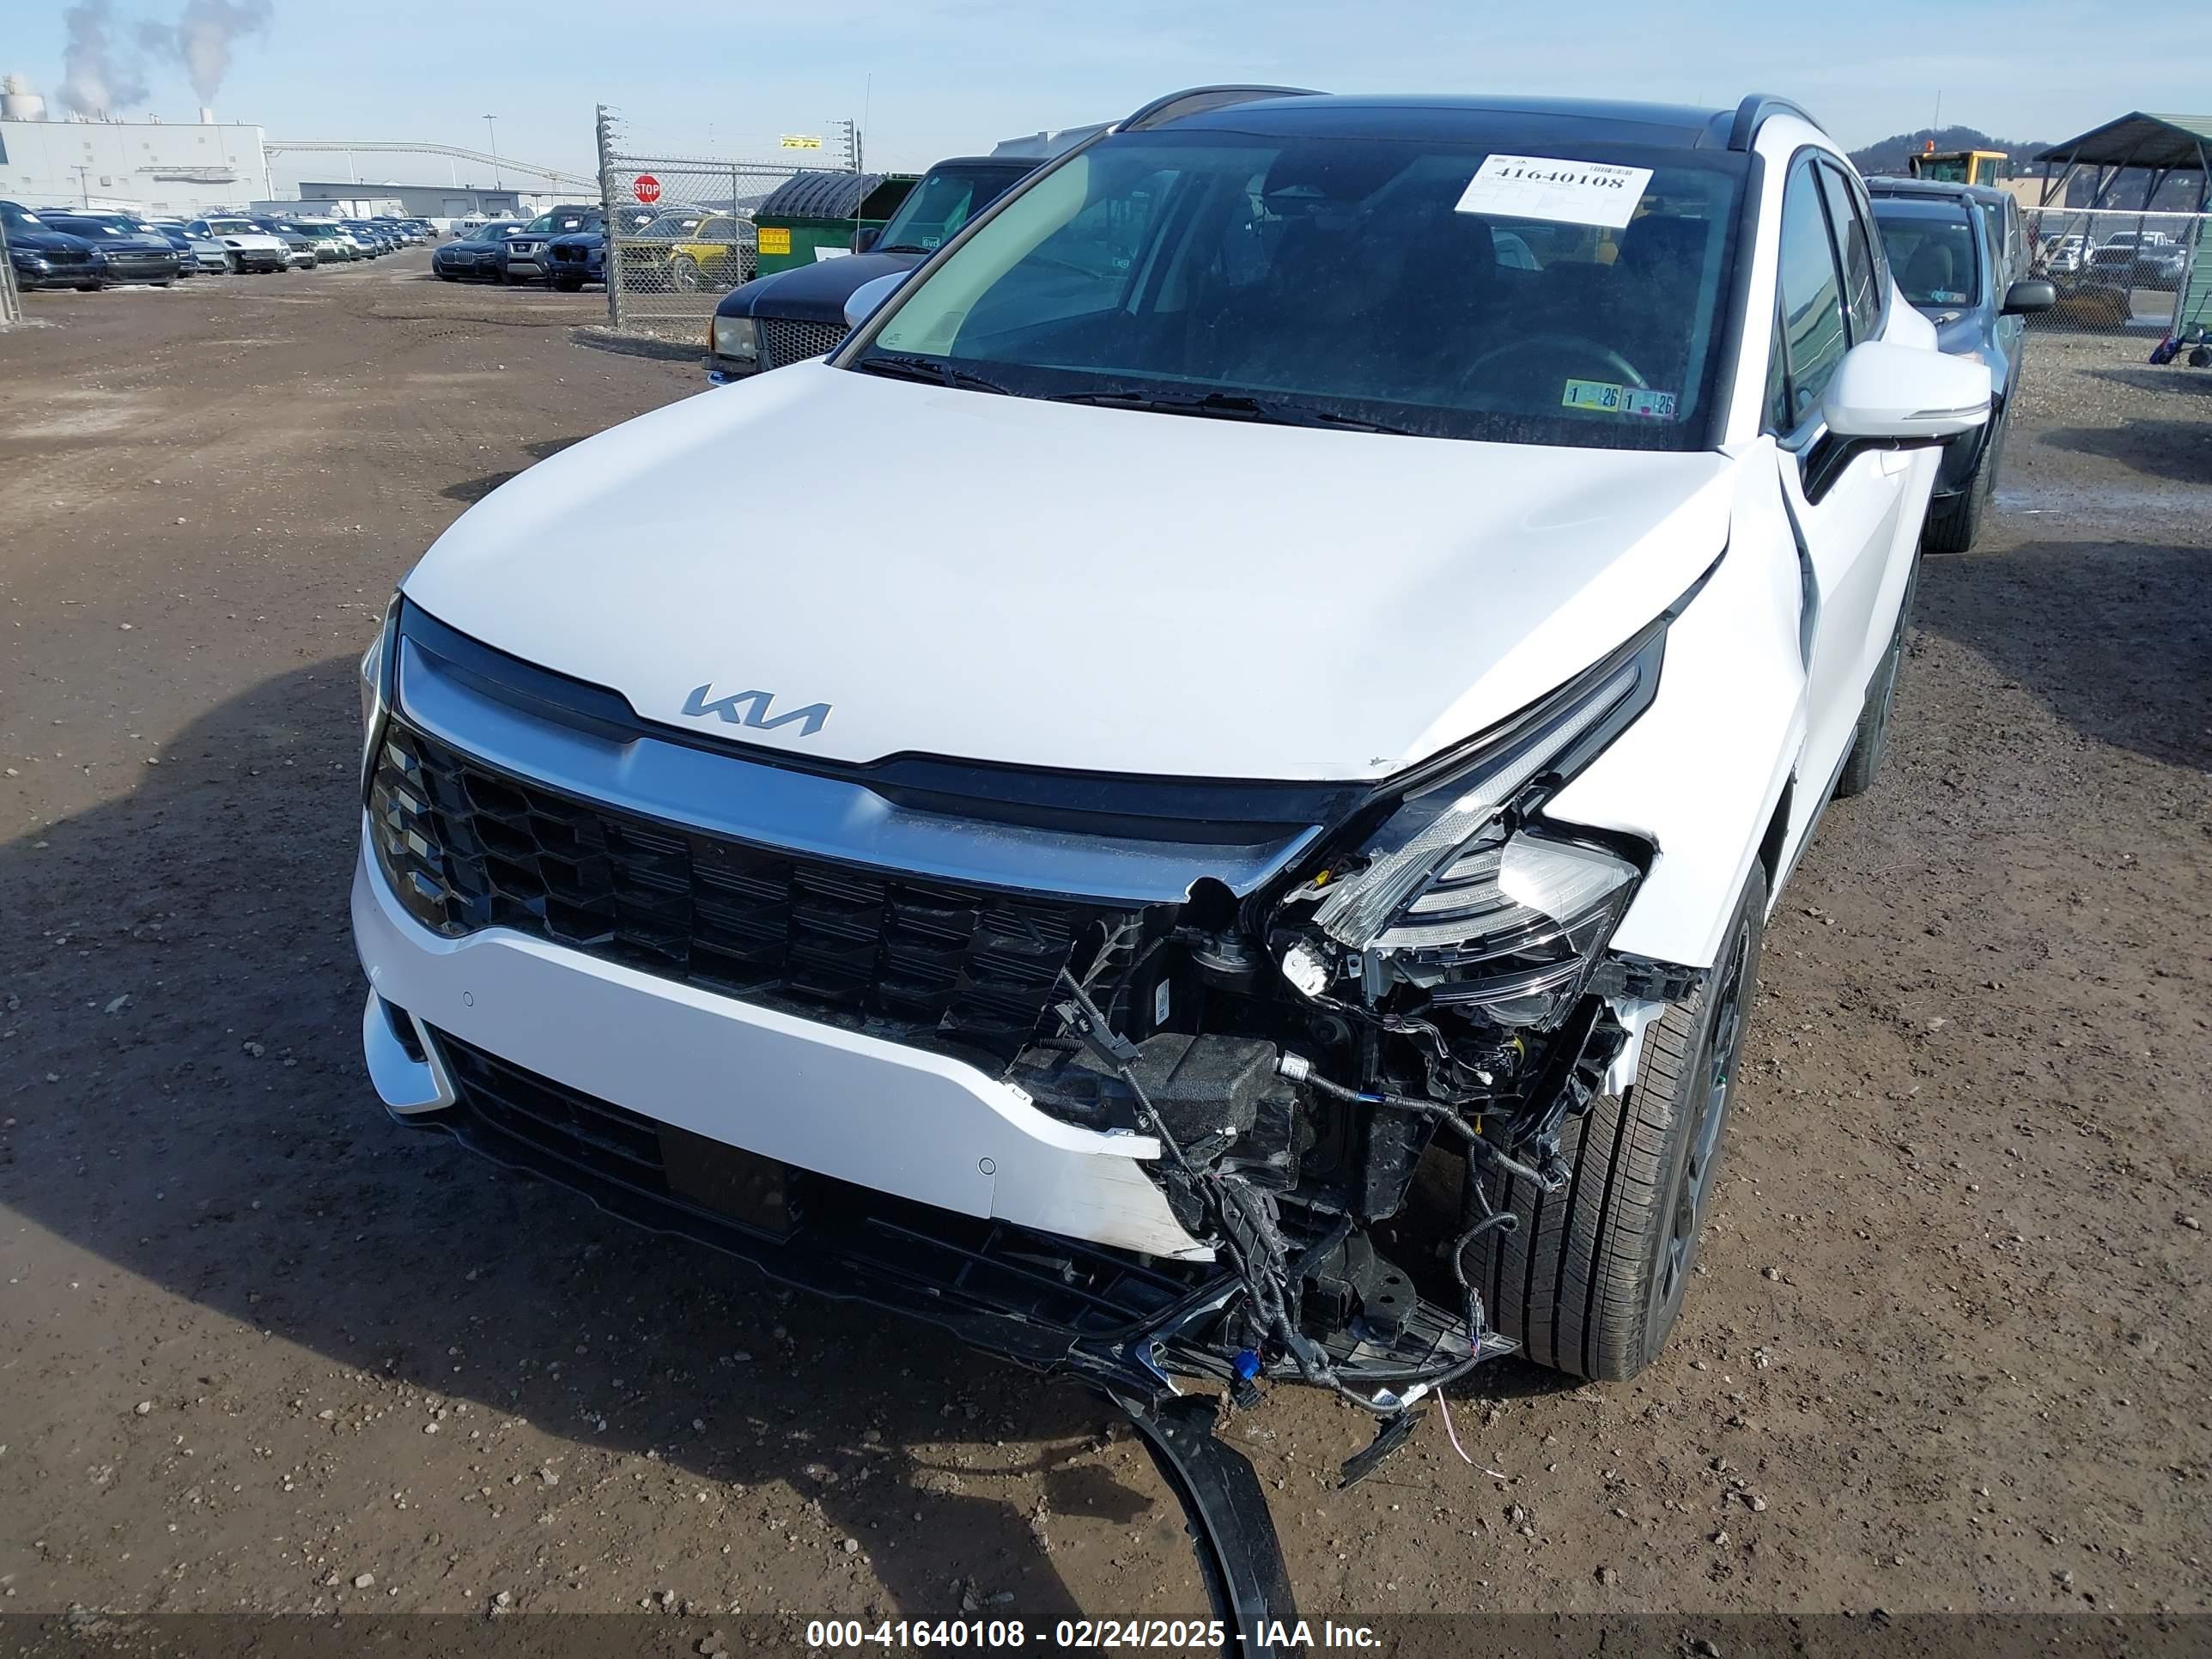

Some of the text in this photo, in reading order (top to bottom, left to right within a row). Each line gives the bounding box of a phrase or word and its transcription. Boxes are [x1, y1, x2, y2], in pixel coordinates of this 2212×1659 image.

[1495, 167, 1626, 189] 41640108
[635, 183, 659, 195] STOP
[1571, 386, 1619, 406] 1 26
[1626, 393, 1674, 414] 1 26
